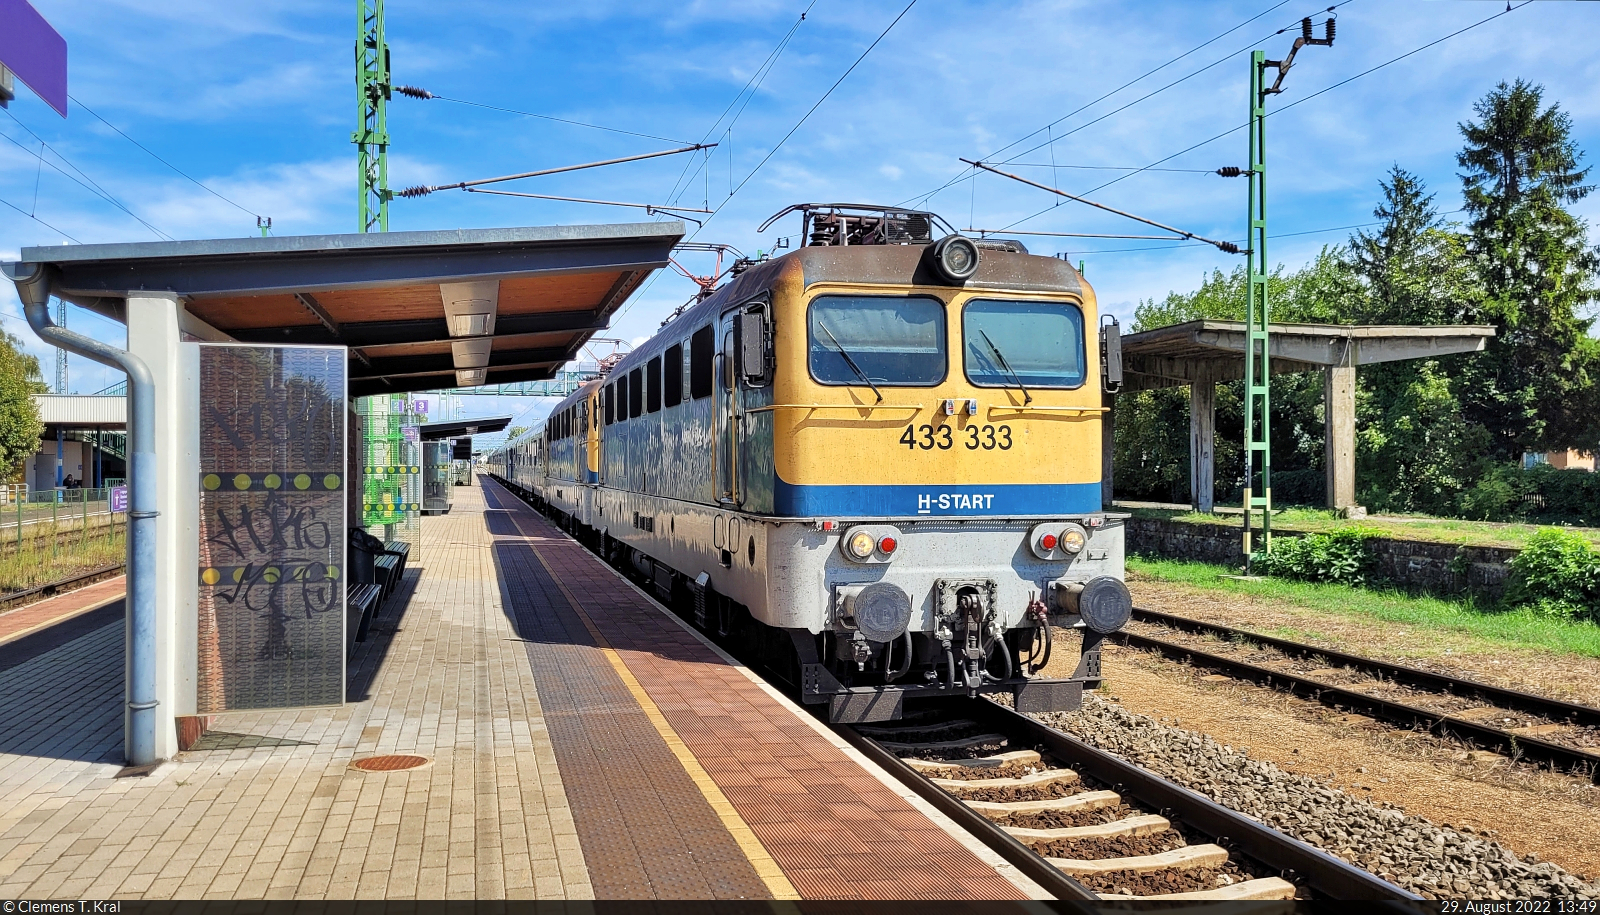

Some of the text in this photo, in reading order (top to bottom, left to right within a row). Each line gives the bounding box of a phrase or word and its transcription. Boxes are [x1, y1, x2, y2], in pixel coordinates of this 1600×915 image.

[899, 424, 1013, 450] 433 333
[918, 493, 995, 514] H-START
